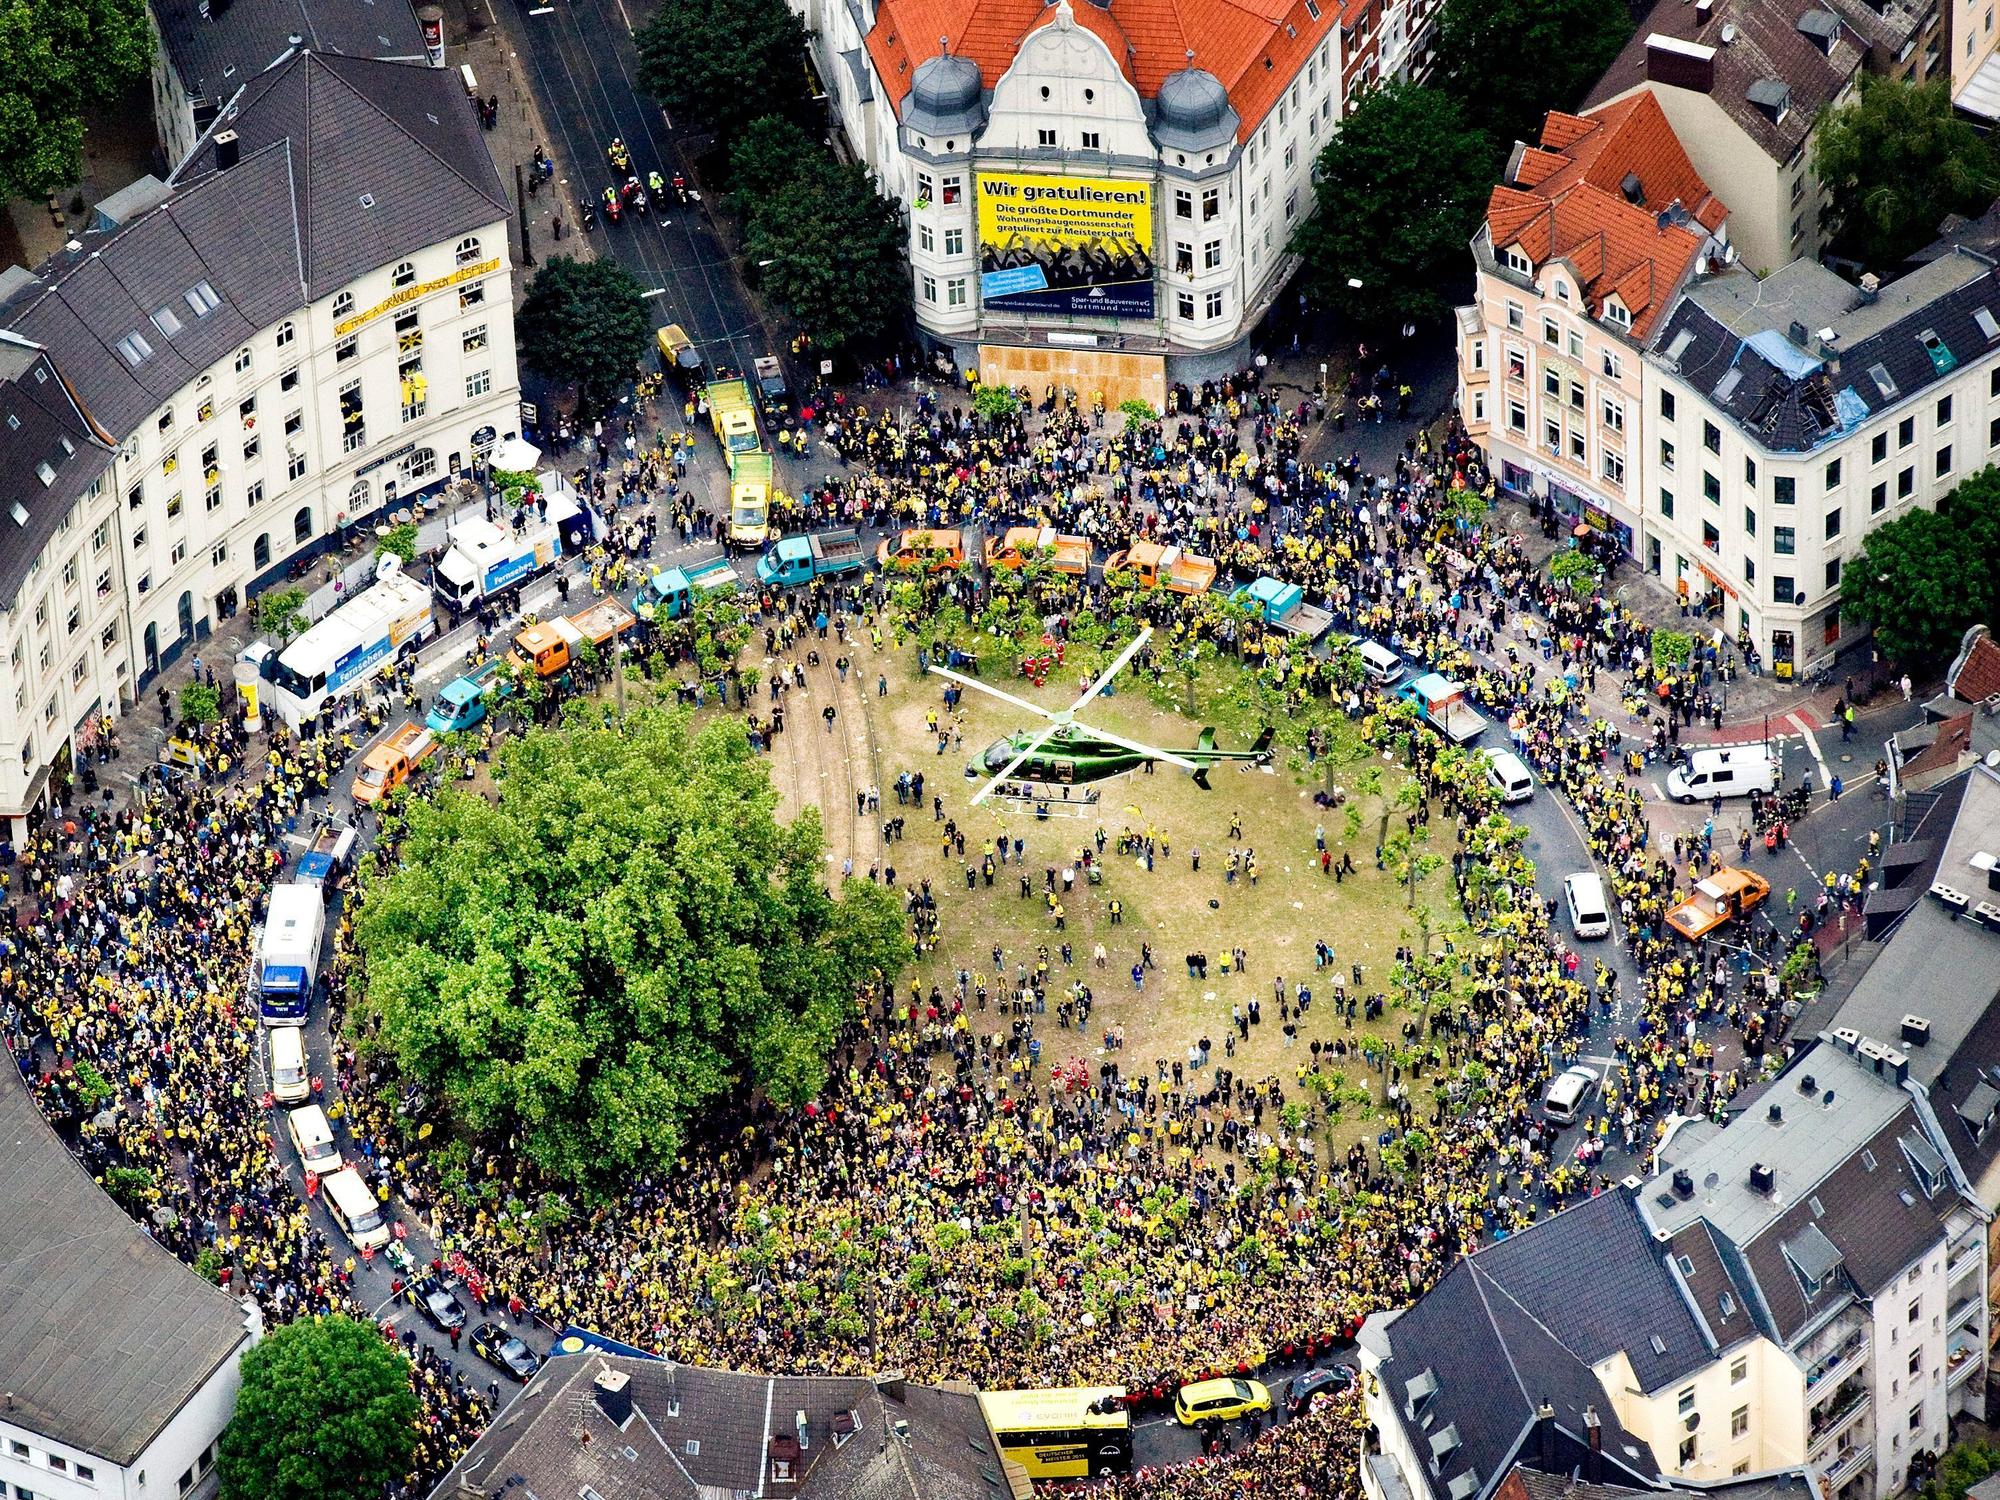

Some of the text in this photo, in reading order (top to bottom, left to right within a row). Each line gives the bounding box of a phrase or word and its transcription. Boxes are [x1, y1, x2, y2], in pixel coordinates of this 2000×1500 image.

[983, 181, 1145, 204] Wir gratulieren!
[996, 204, 1134, 219] Die größte Dortmunder
[996, 215, 1135, 229] Wohnungsbaugenossenschaft
[997, 225, 1045, 234] gratuliert
[1064, 228, 1134, 238] Meisterschaft!
[1071, 296, 1089, 304] Spar-
[1104, 298, 1139, 306] Bauverein
[1071, 302, 1118, 311] Dortmund
[494, 561, 534, 585] Fernsehen
[340, 647, 384, 683] Fernsehen
